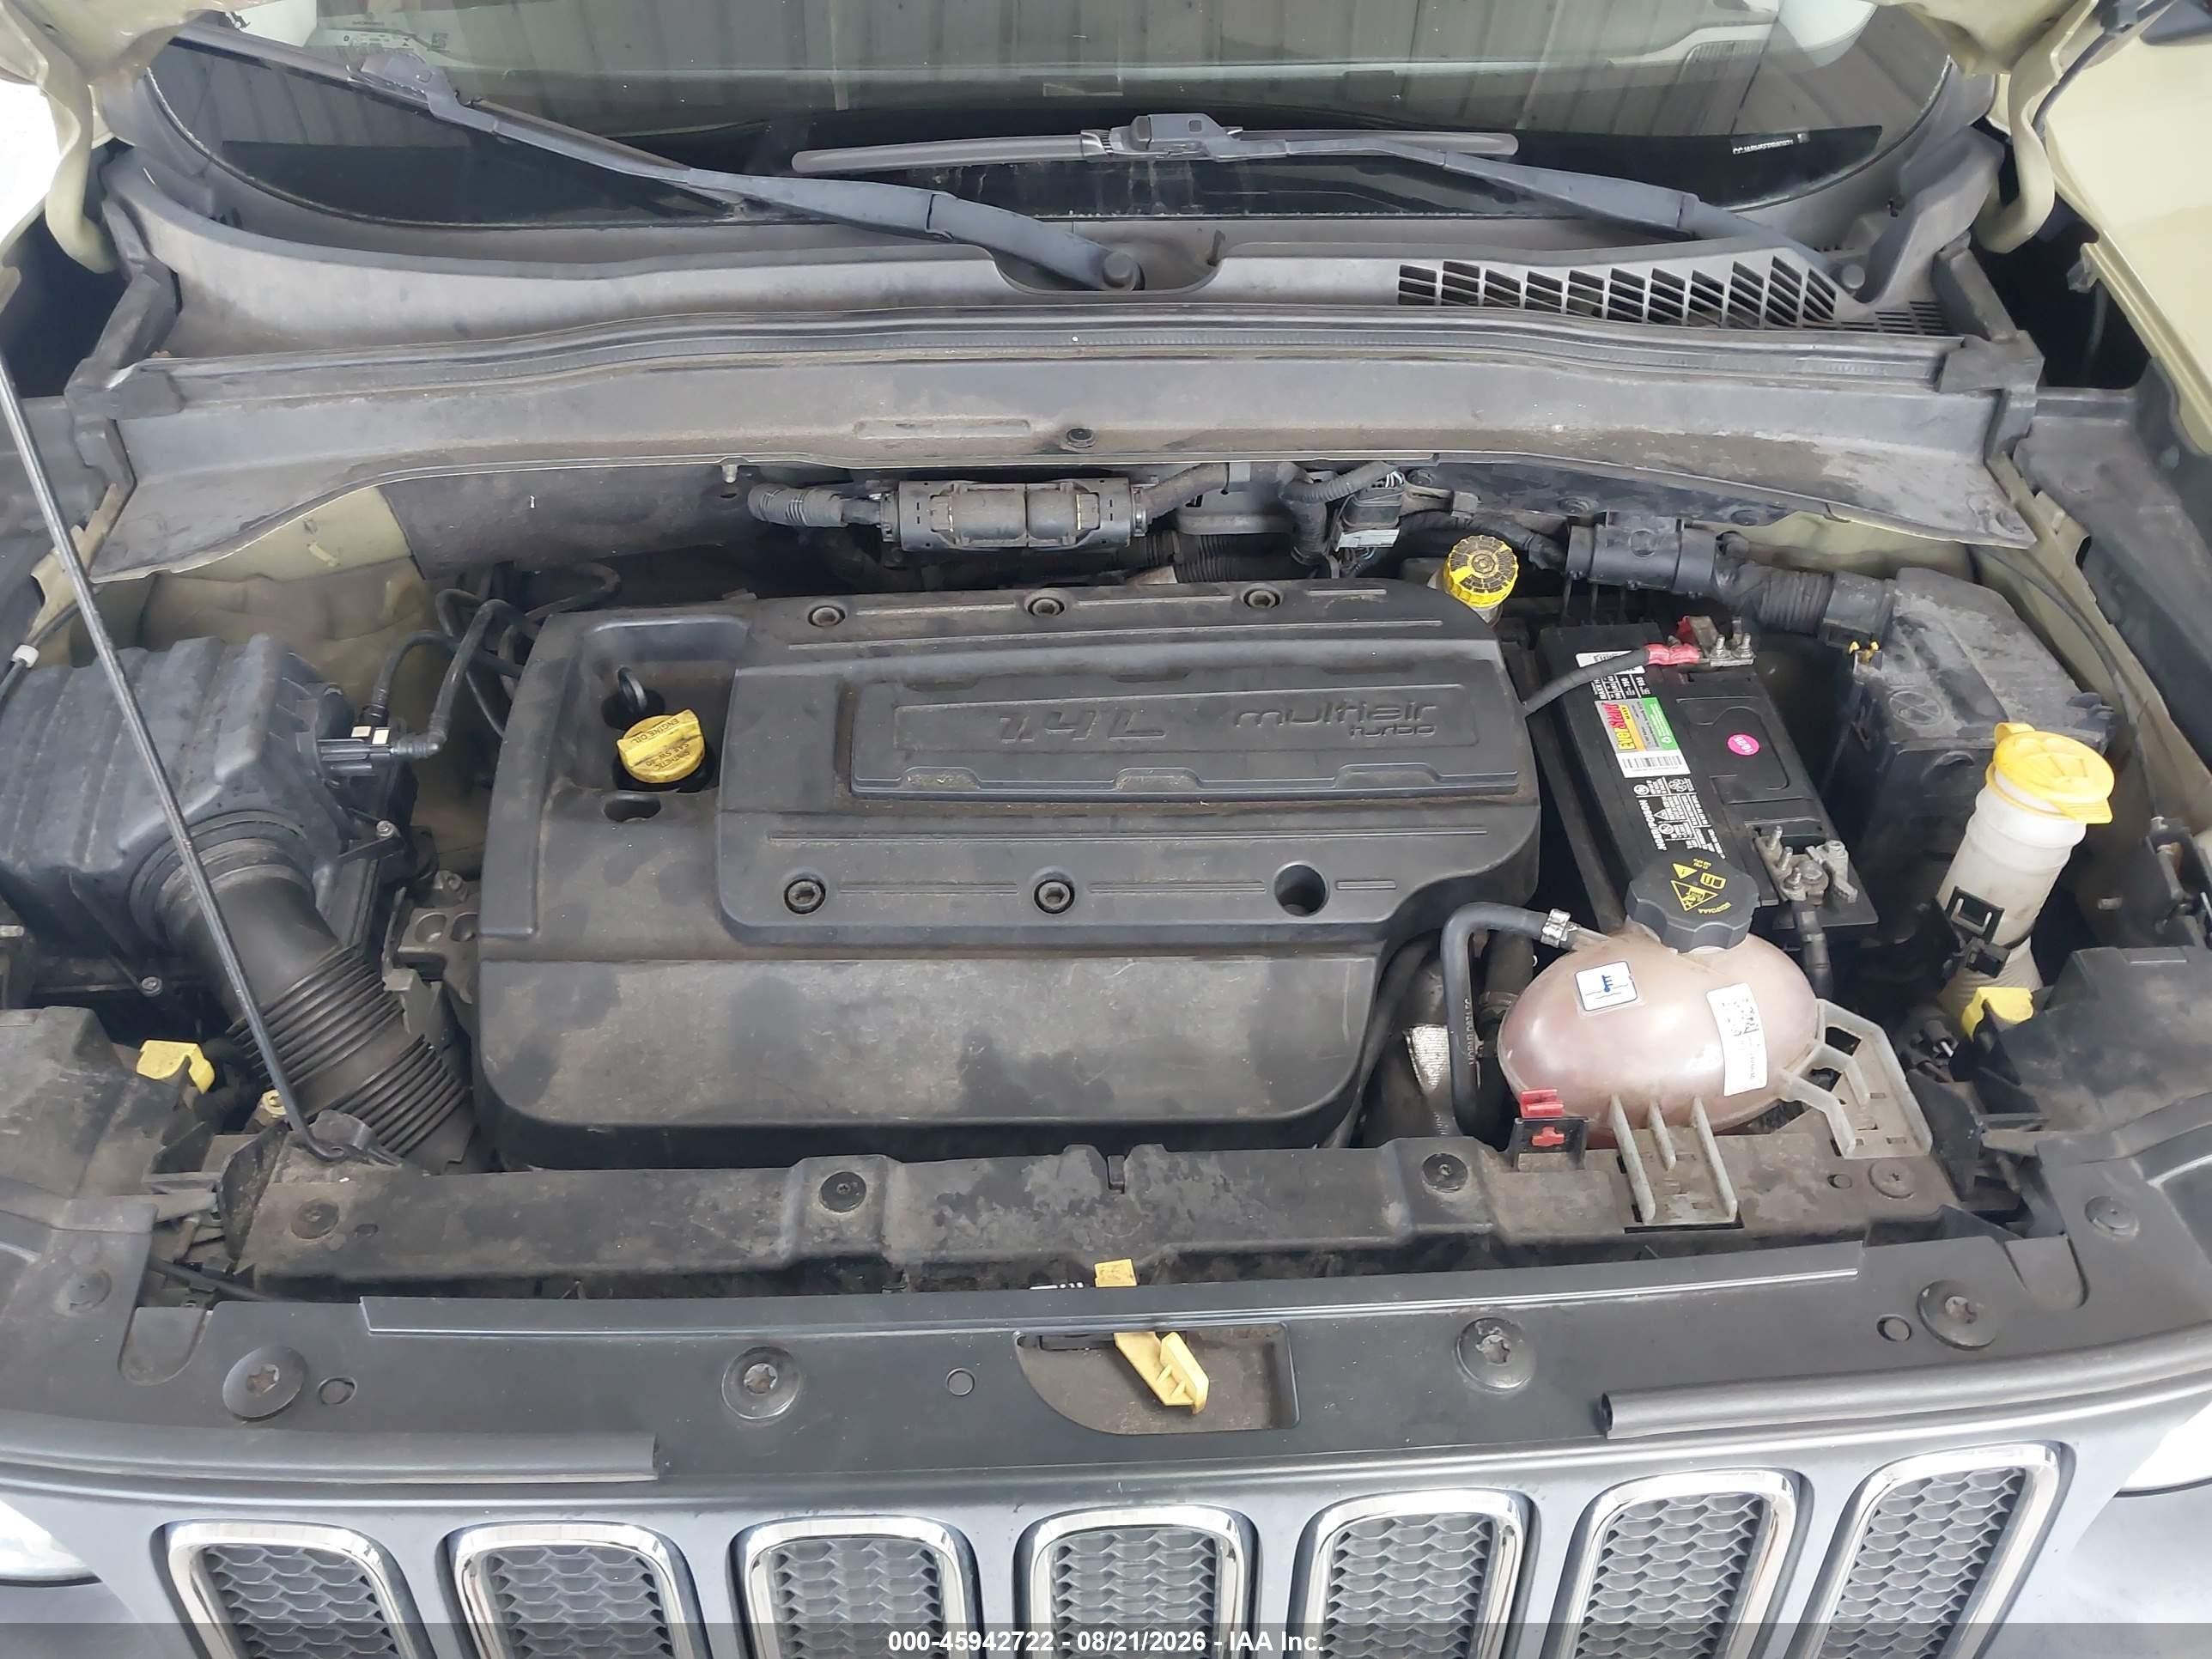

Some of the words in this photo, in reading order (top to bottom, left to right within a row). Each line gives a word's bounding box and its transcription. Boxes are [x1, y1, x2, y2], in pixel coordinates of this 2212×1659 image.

[1235, 700, 1437, 727] multiair
[647, 718, 680, 737] ENGINE
[1350, 722, 1437, 740] turbo
[1601, 702, 1636, 750] EverStart
[630, 733, 647, 744] OIL
[654, 750, 691, 771] SYNTHETIC
[1638, 799, 1667, 850] NGER/POISON
